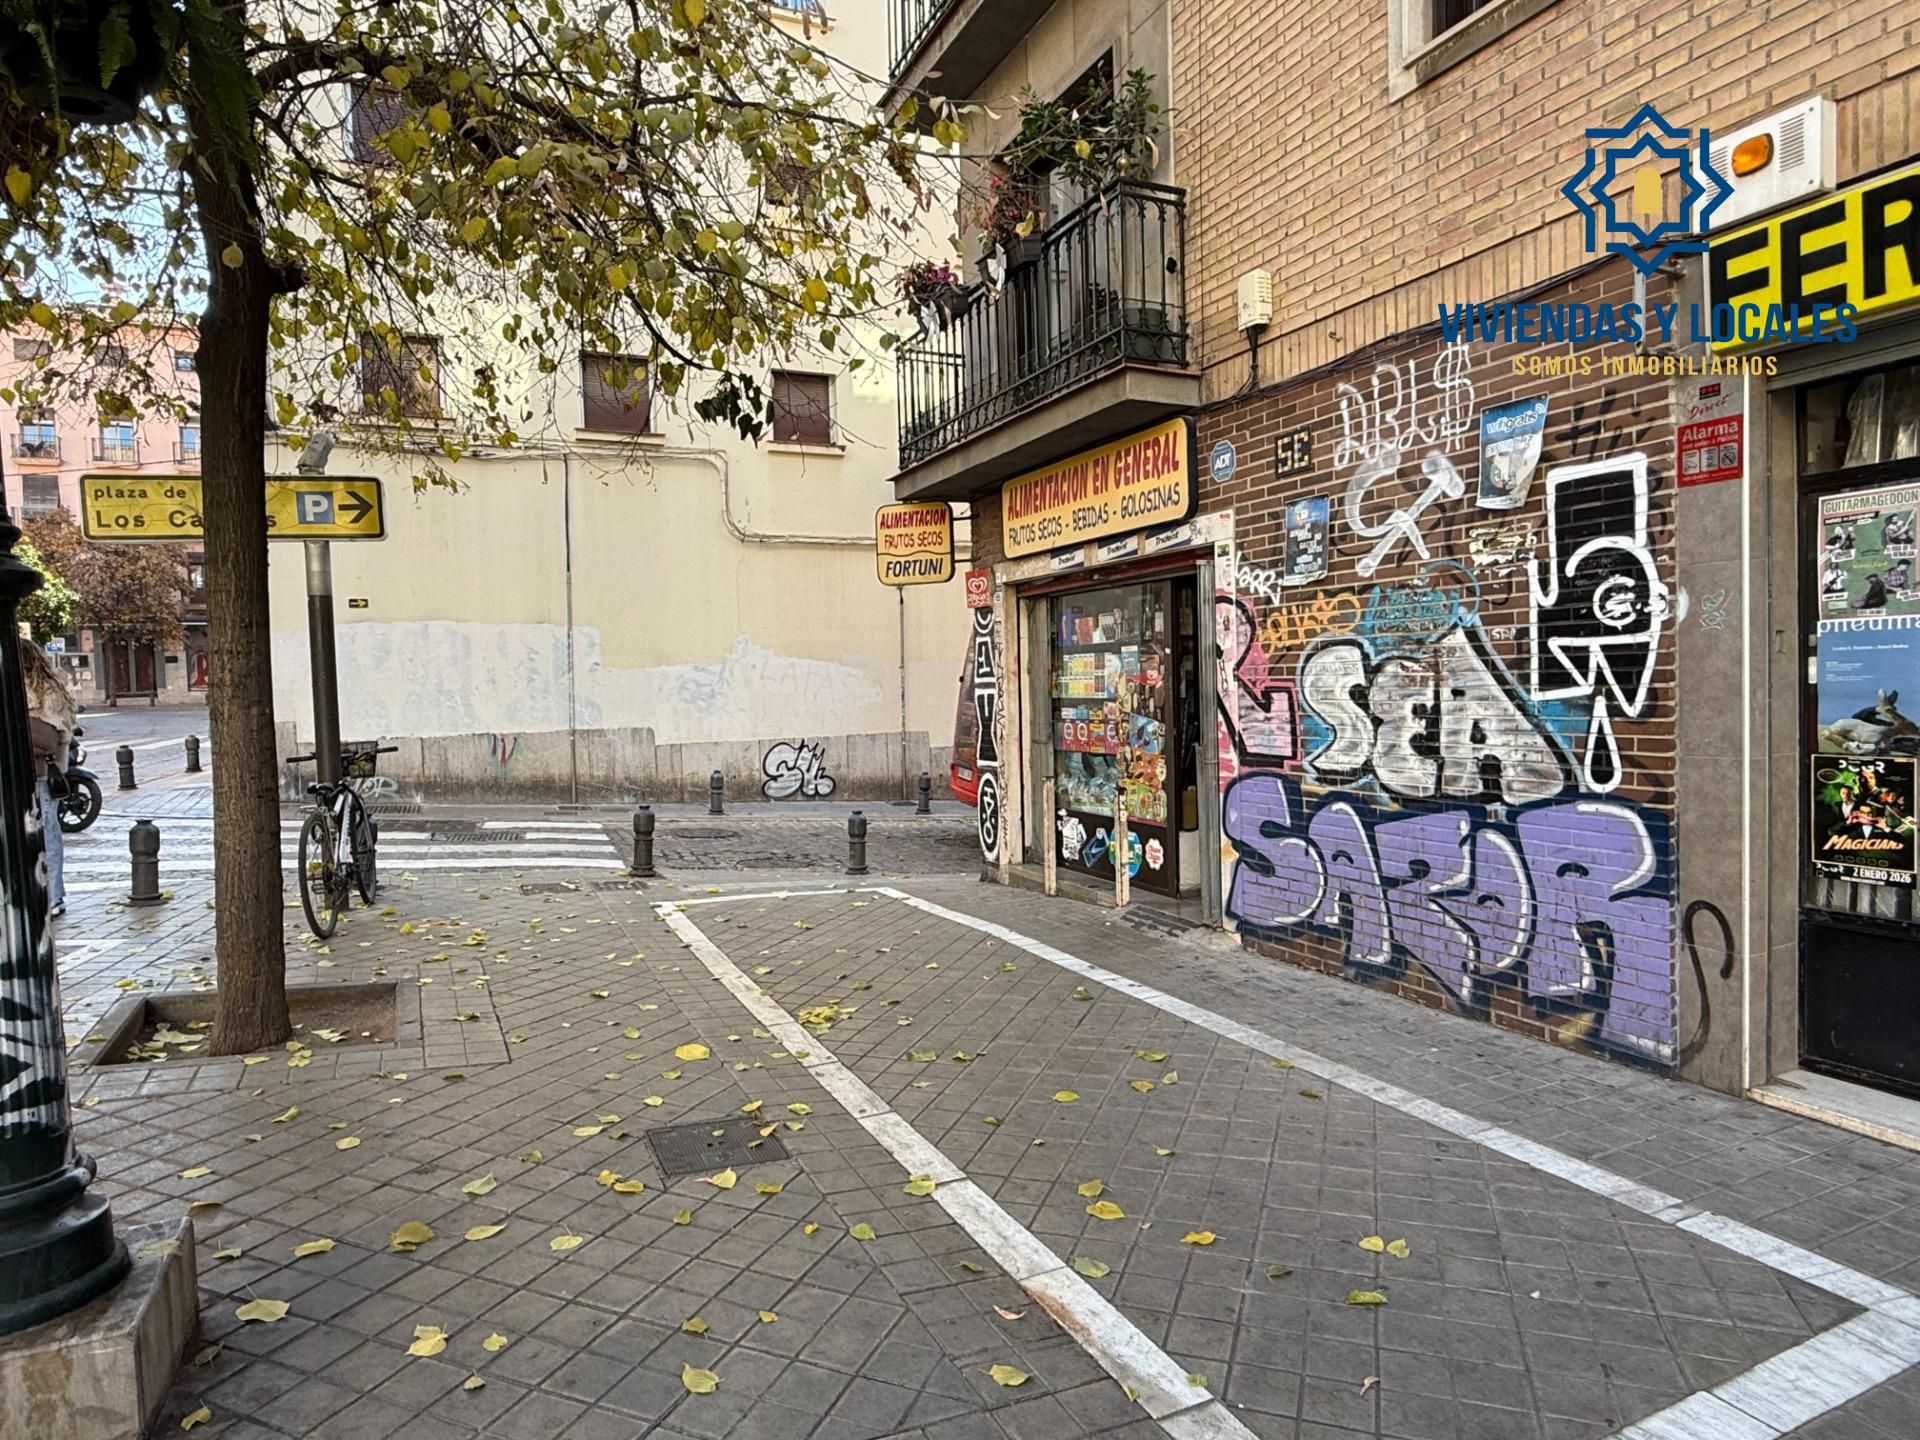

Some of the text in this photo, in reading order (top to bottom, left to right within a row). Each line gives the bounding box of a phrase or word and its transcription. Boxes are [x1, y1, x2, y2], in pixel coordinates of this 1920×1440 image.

[1682, 421, 1738, 442] Alarma
[1214, 452, 1231, 470] ADT
[1007, 430, 1179, 521] ALIMENTACION EN GENERAL
[93, 484, 187, 500] plaza de
[1825, 490, 1919, 513] GUITARMAGEDDON
[96, 510, 146, 528] Los
[880, 508, 947, 530] ALIMENTACION
[1009, 482, 1180, 548] FRUTOS SECOS BEBIDAS GOLOSINAS
[884, 530, 944, 551] FRUTOS SECOS
[885, 558, 944, 578] FORTUNI
[1852, 867, 1858, 877] 2
[1860, 868, 1887, 881] ENERO
[1889, 871, 1912, 884] 2026
